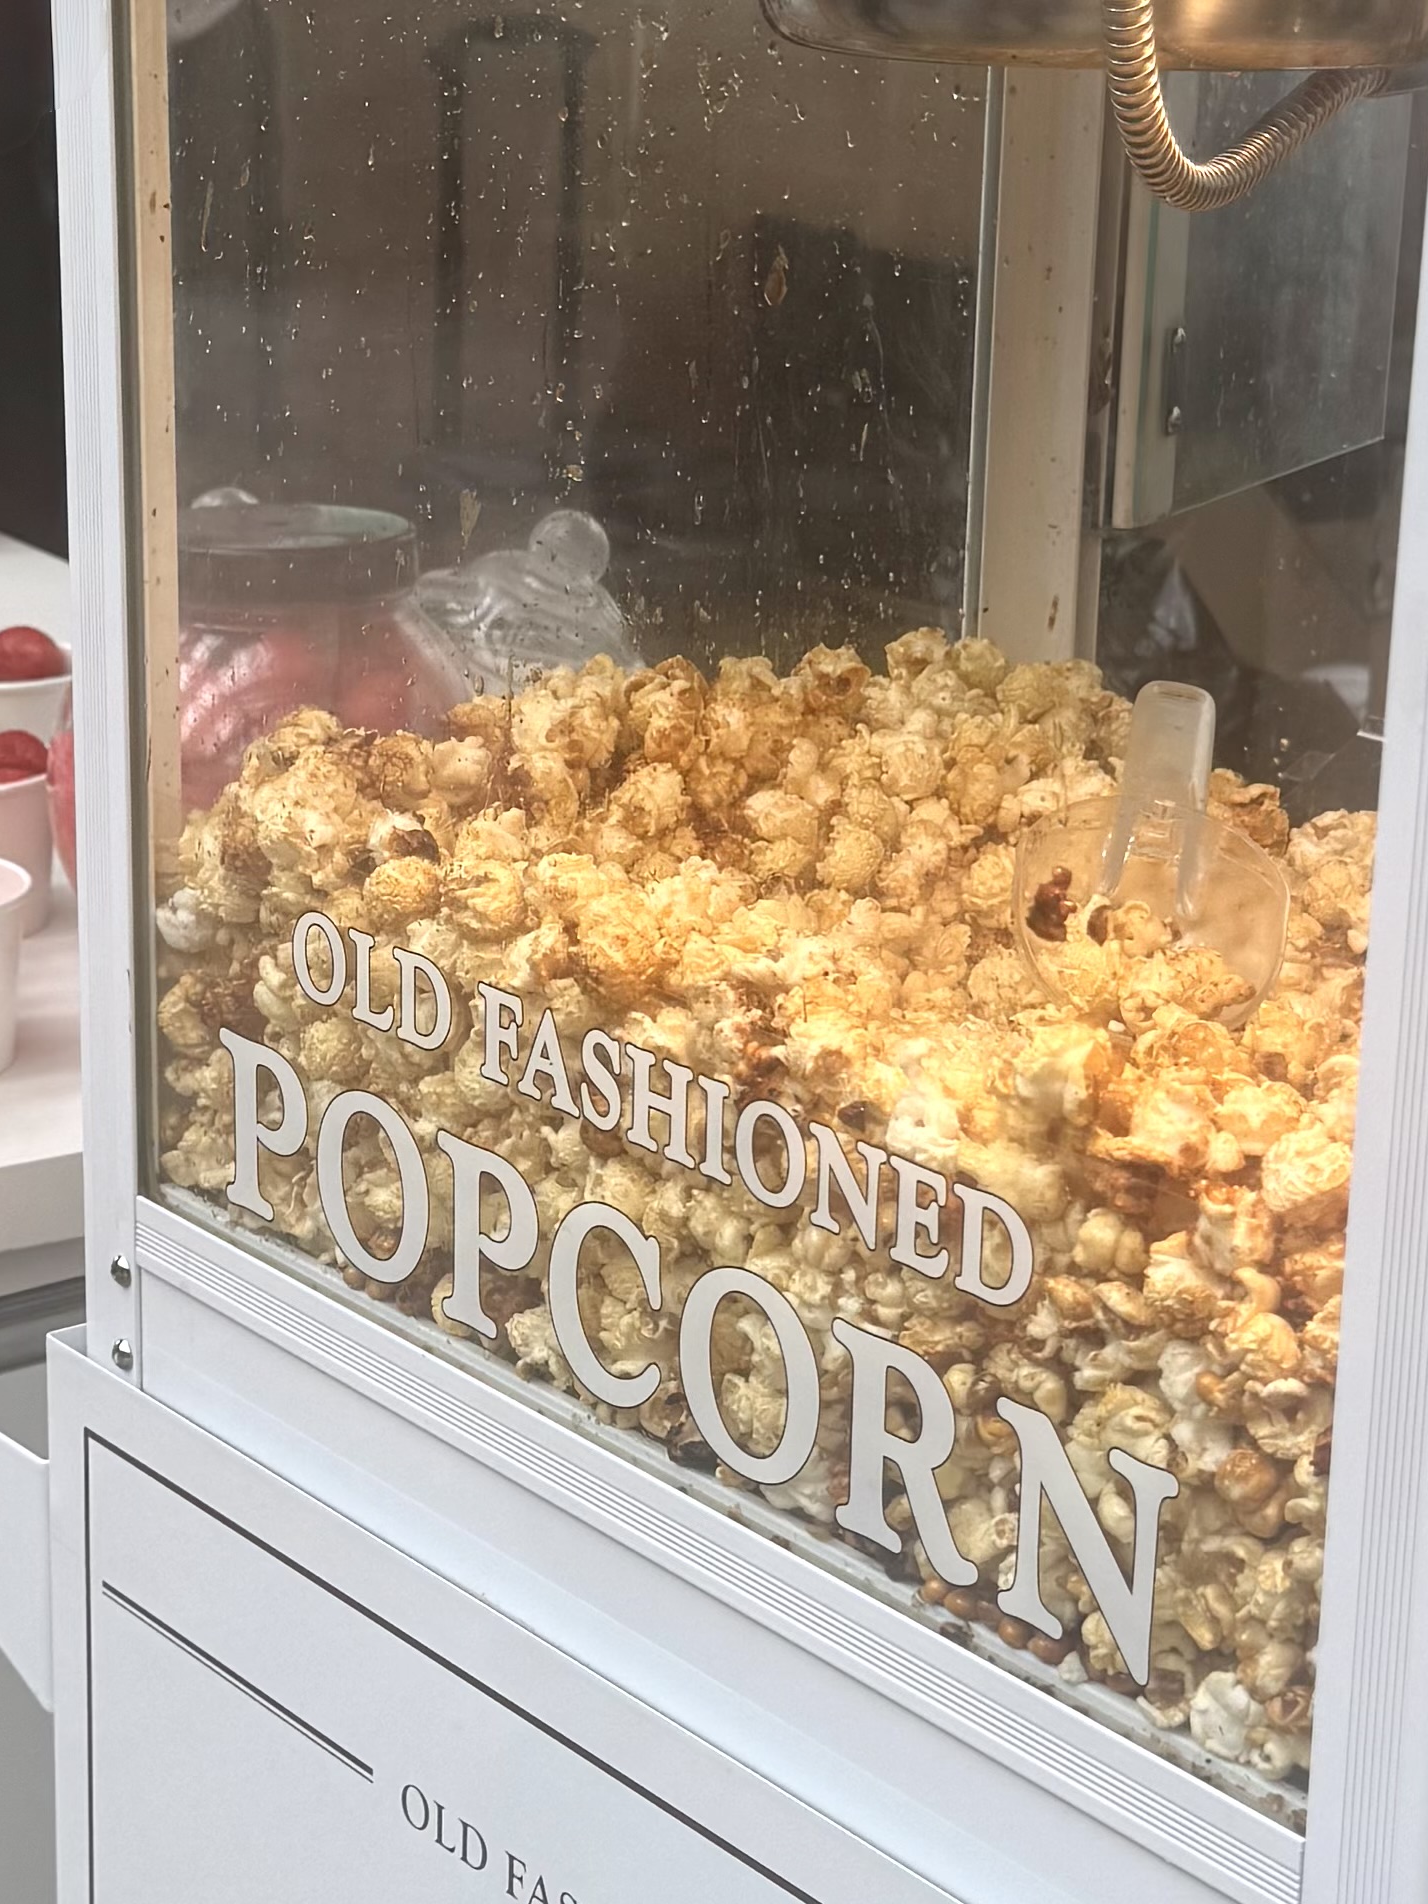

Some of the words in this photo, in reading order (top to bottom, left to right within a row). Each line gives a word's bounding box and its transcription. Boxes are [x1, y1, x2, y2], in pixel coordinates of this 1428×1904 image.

[291, 910, 452, 1050] OLD
[476, 981, 1034, 1308] FASHIONED
[218, 1027, 1180, 1686] POPCORN
[399, 1783, 488, 1871] OLD
